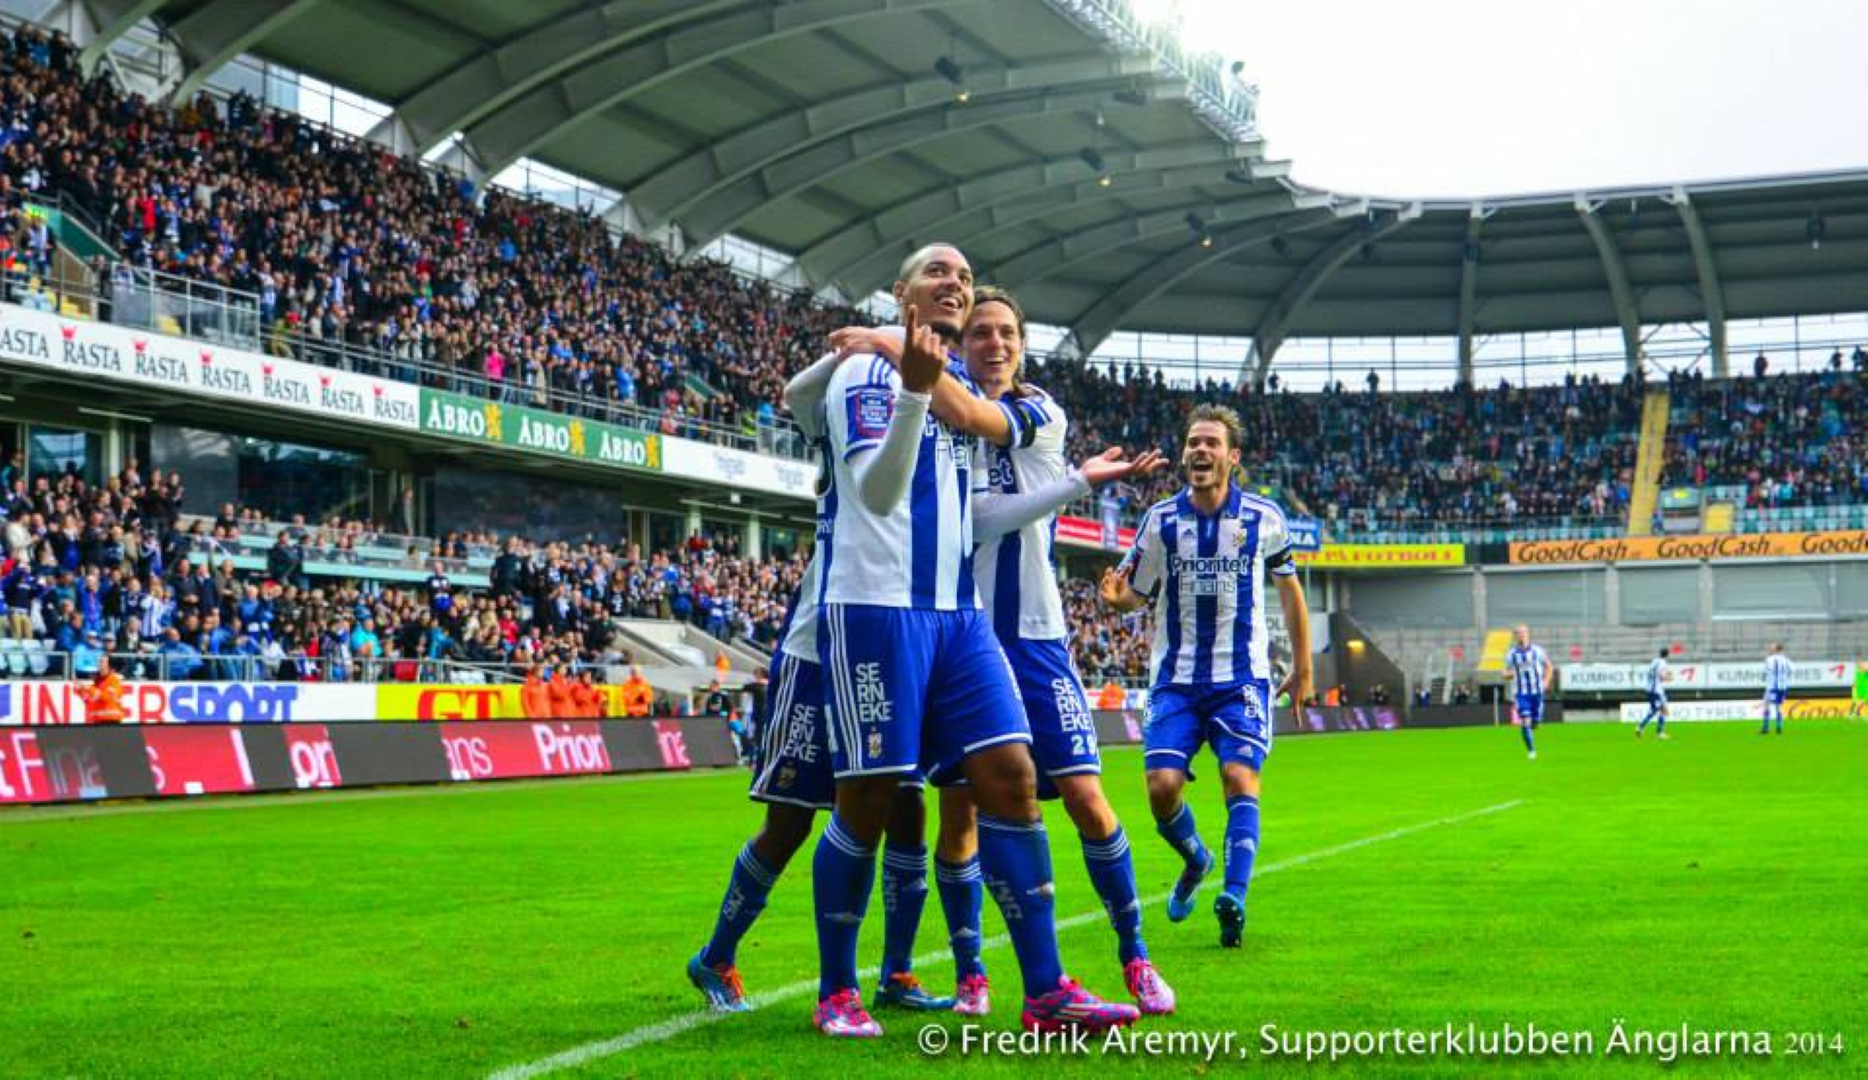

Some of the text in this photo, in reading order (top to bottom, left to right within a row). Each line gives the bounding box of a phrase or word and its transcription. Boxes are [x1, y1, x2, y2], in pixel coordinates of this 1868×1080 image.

[63, 340, 121, 371] RASTA
[136, 353, 188, 383] RASTA
[202, 364, 252, 393] RASTA
[264, 376, 310, 405] RASTA
[321, 387, 364, 414] RASTA
[375, 398, 415, 422] RASTA
[1518, 531, 1868, 563] GoodCash GoodCash Good
[1170, 553, 1249, 577] Prioritet
[1179, 575, 1237, 594] Finans
[856, 662, 880, 684] SE
[1571, 670, 1625, 684] KUMHO
[857, 682, 886, 703] RN
[417, 688, 503, 720] GT
[859, 702, 893, 723] EKE
